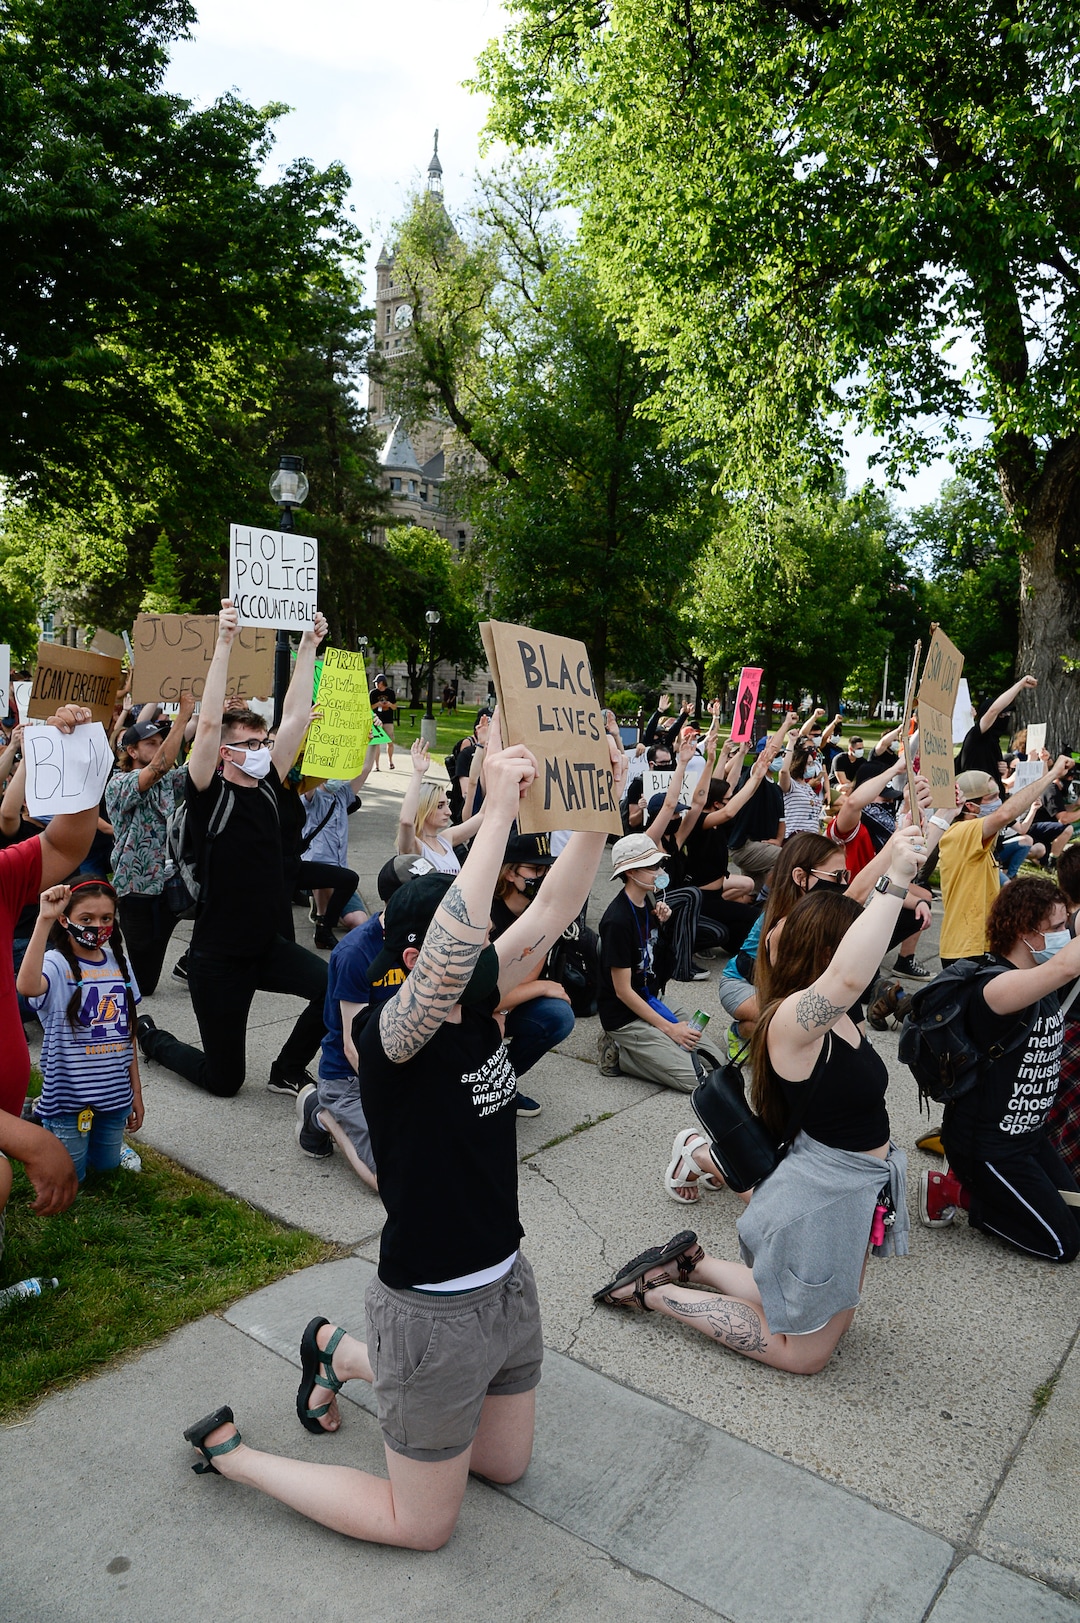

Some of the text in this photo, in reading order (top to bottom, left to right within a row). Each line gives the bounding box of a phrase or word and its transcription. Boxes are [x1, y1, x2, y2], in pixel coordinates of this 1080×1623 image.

[235, 528, 315, 563] HOLD
[236, 559, 317, 592] POLICE
[233, 593, 317, 622] ACCOUNTABLE
[139, 617, 268, 652] JUSTCE
[31, 666, 44, 700] I
[71, 672, 116, 707] BREATHE
[159, 674, 251, 700] GEOGE
[537, 704, 601, 742] LIVES
[29, 735, 110, 800] BLM
[651, 773, 690, 791] BLAK
[543, 756, 617, 812] MATTER
[472, 1083, 490, 1093] OR
[472, 1090, 503, 1106] WHEN
[1012, 1082, 1042, 1097] you
[478, 1102, 502, 1118] JUST
[1002, 1112, 1040, 1125] side
